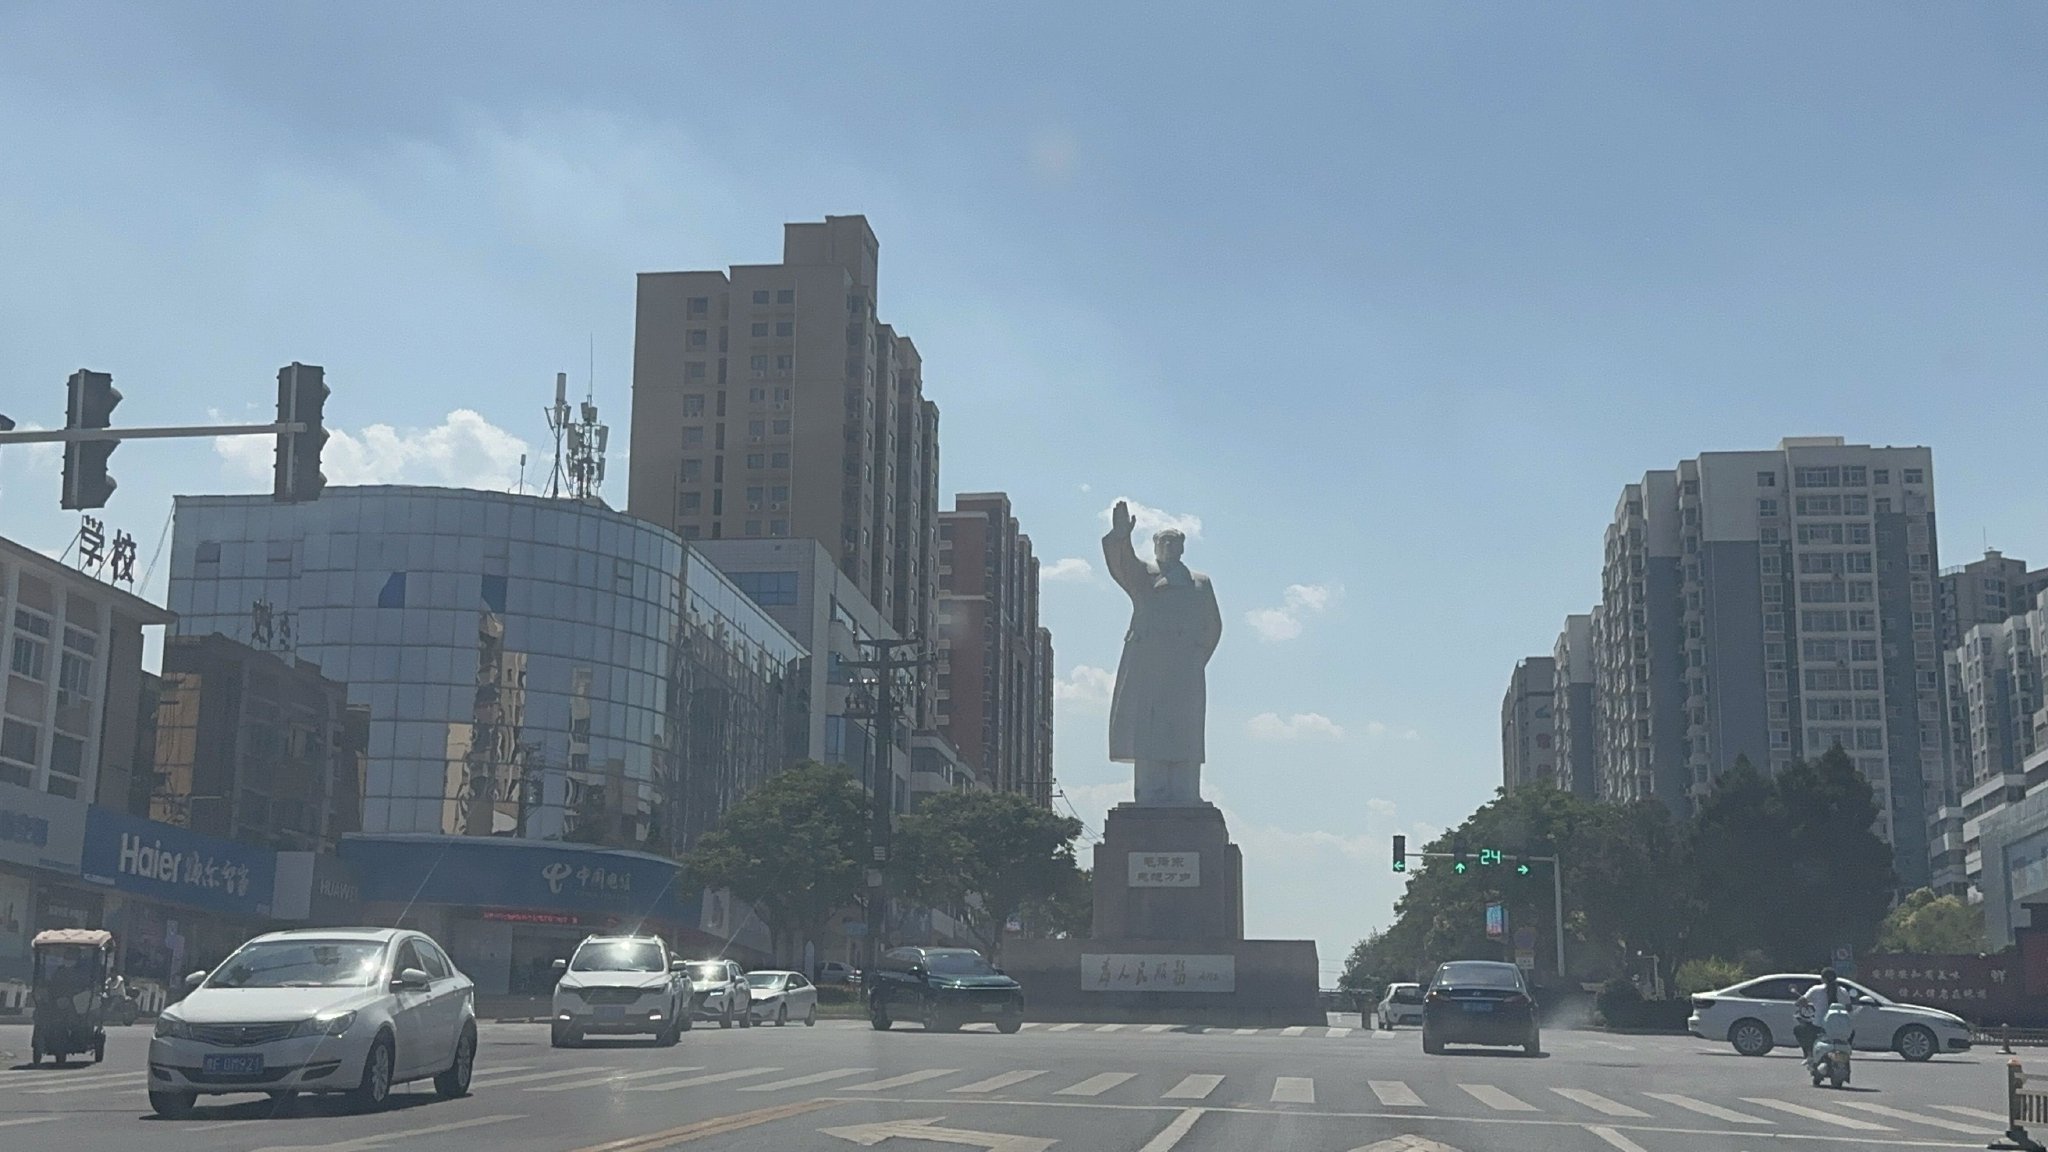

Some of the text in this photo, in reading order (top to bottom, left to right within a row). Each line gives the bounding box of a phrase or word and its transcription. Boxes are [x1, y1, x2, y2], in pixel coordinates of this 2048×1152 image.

[80, 515, 138, 584] 学校
[118, 832, 182, 883] Haier
[1481, 849, 1501, 865] 24
